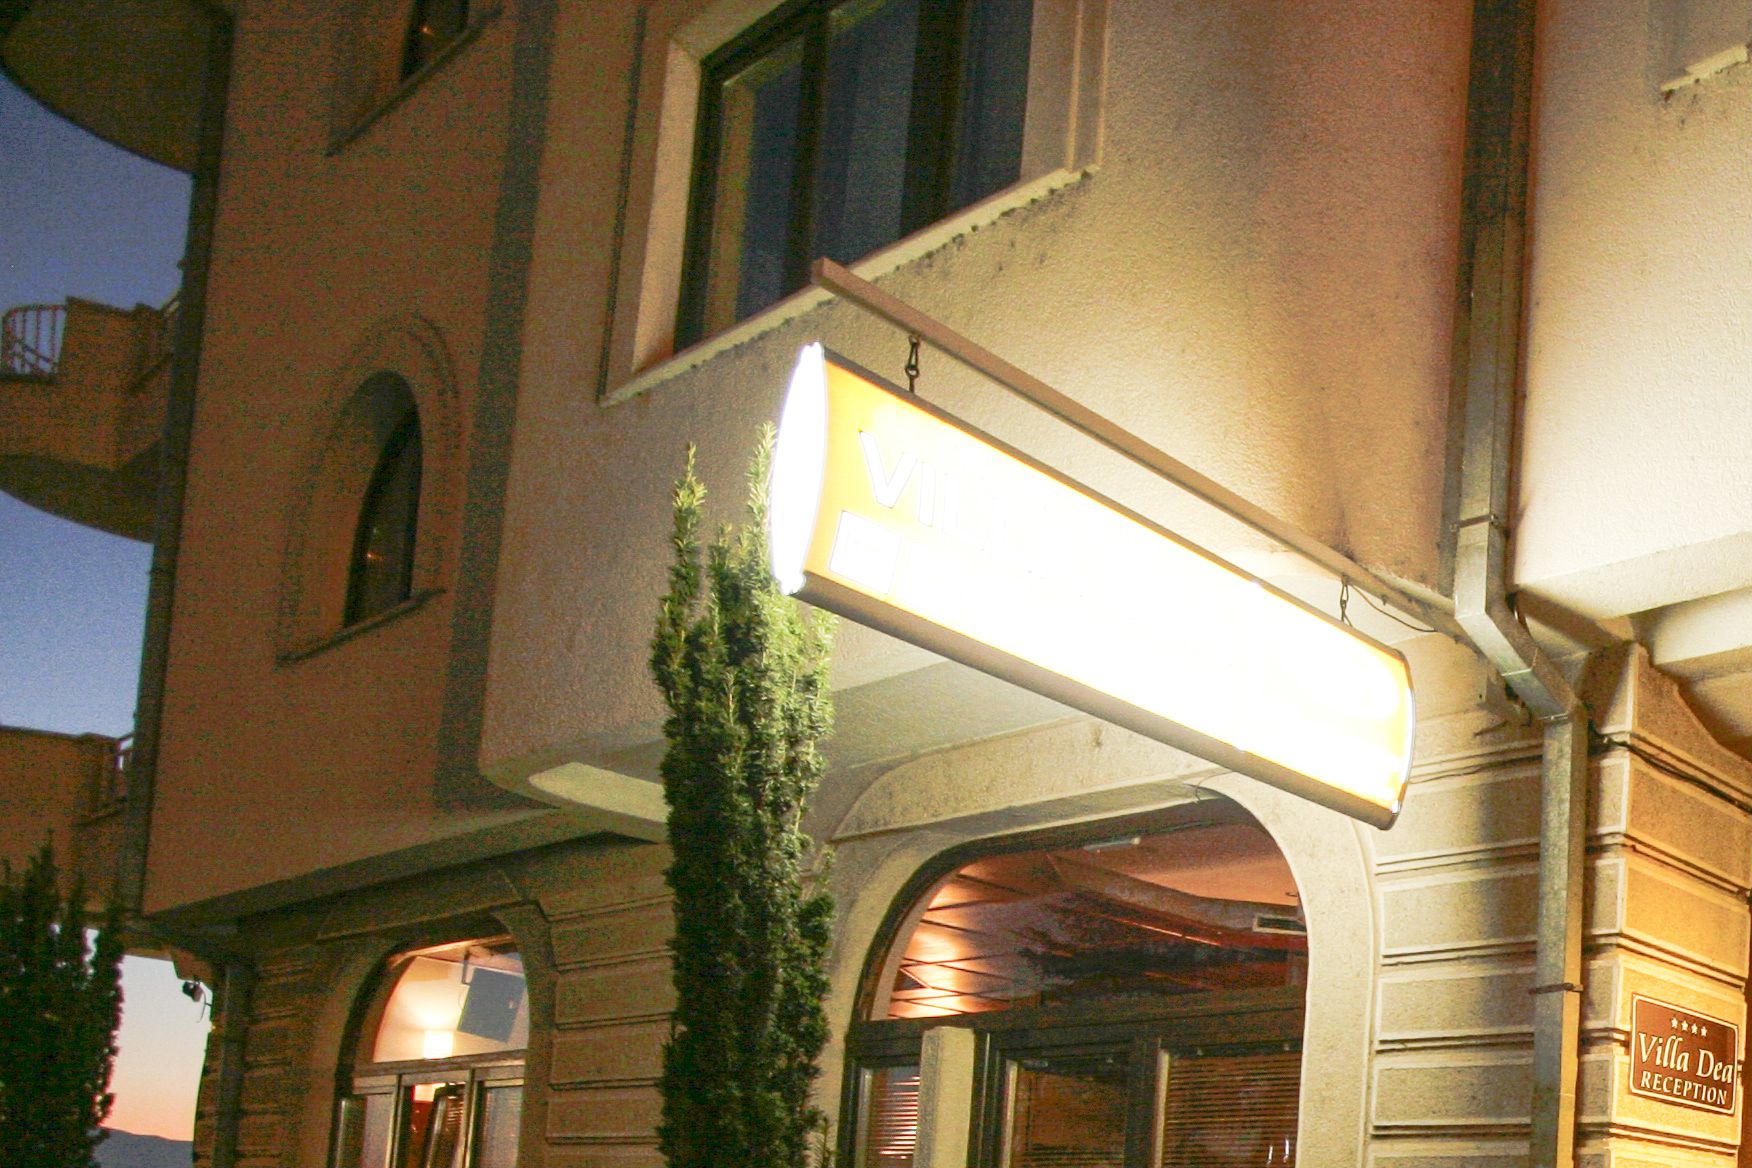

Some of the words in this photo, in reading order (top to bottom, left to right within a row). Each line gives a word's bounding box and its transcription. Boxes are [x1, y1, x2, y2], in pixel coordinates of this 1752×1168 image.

[1638, 1032, 1690, 1072] Villa
[1696, 1048, 1734, 1084] Dea
[1640, 1070, 1728, 1105] RECEPTION
